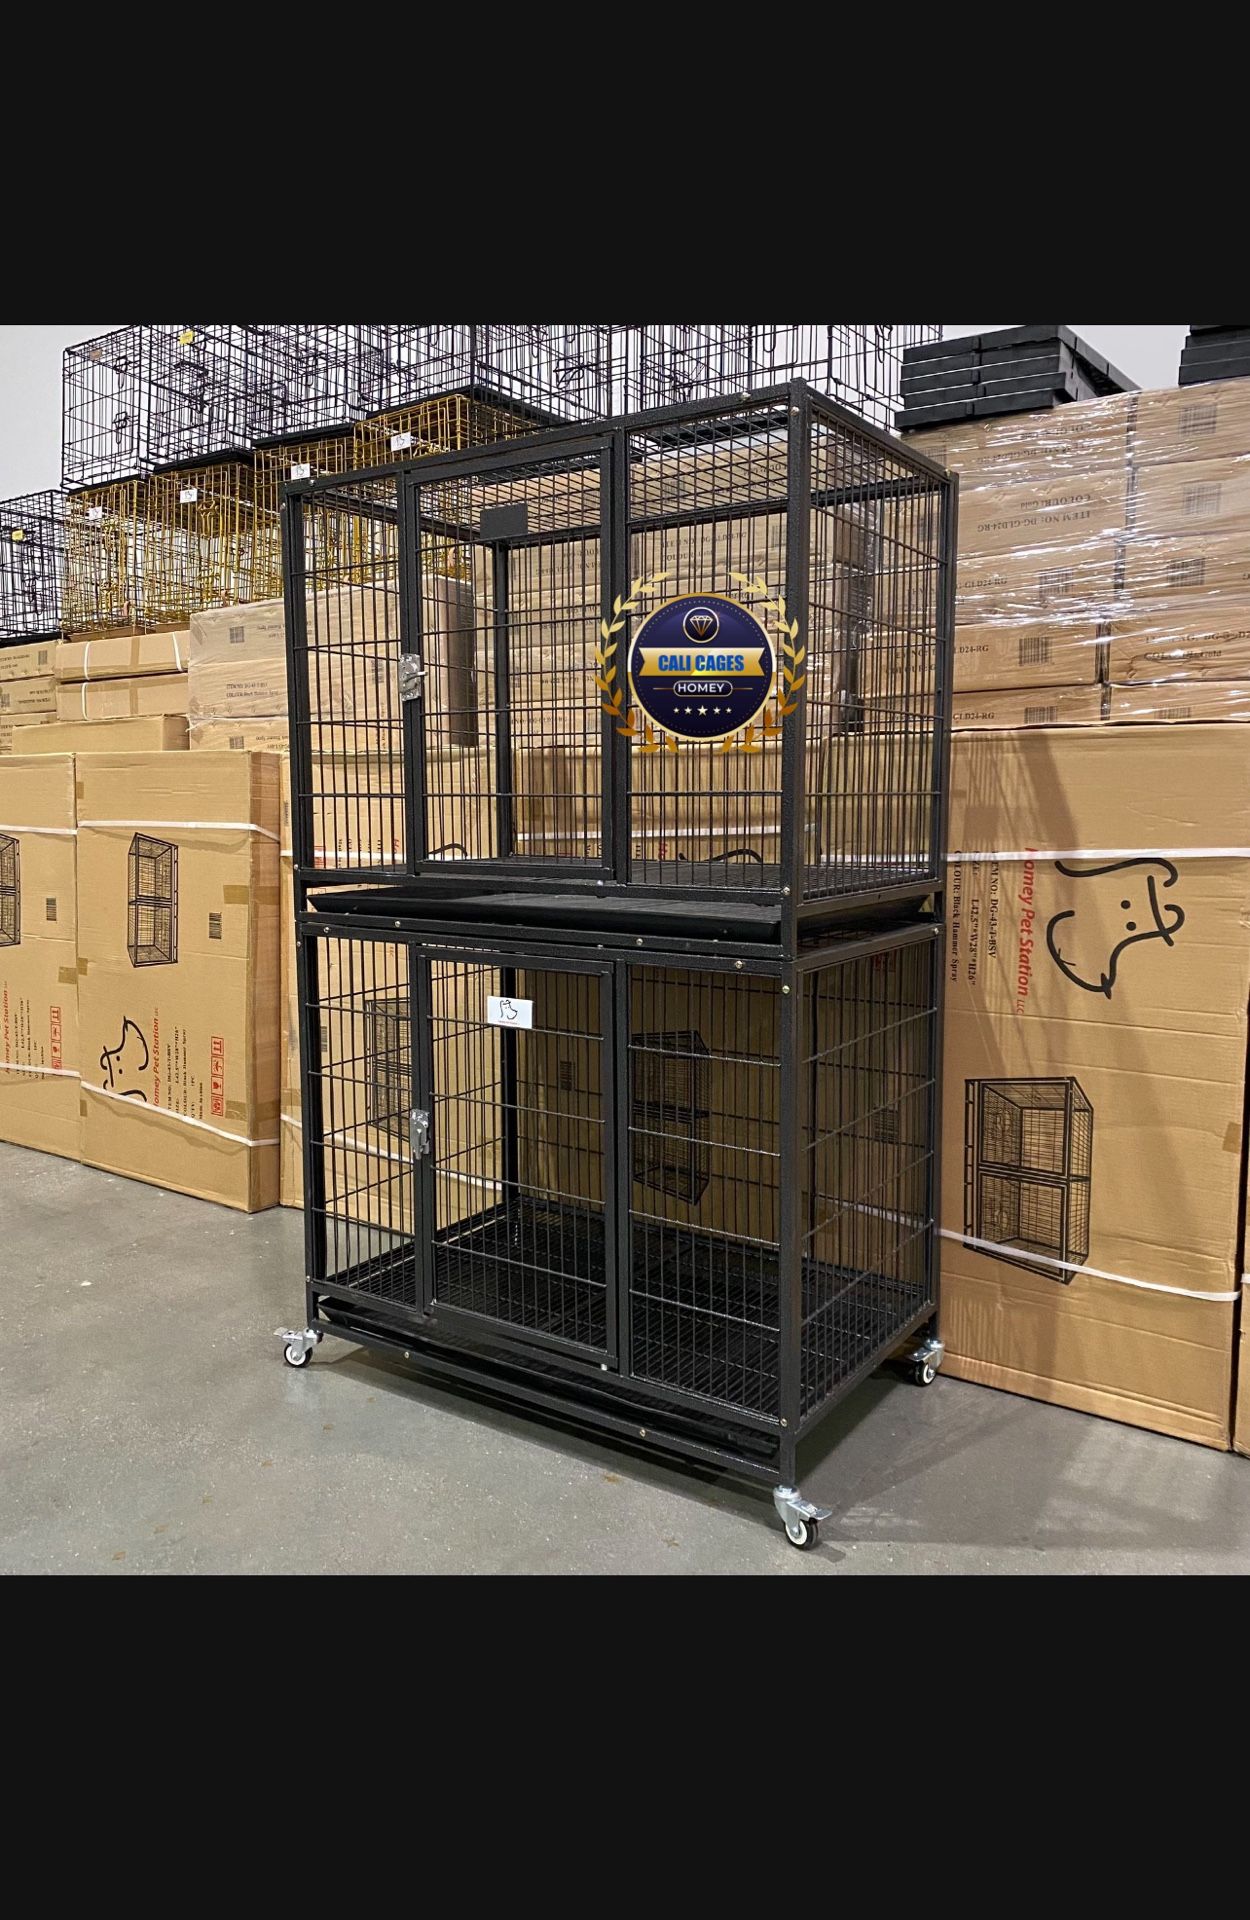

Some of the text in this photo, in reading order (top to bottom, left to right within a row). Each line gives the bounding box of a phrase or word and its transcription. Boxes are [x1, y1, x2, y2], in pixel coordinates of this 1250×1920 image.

[1040, 513, 1060, 523] NO:
[1063, 510, 1091, 521] ITEM
[950, 850, 962, 983] LOUR: Black Hammer Spray
[987, 850, 999, 959] EM NO: DG-43-T-BSV
[1016, 848, 1039, 1015] omey Pet Station LLC
[152, 1017, 160, 1058] Station
